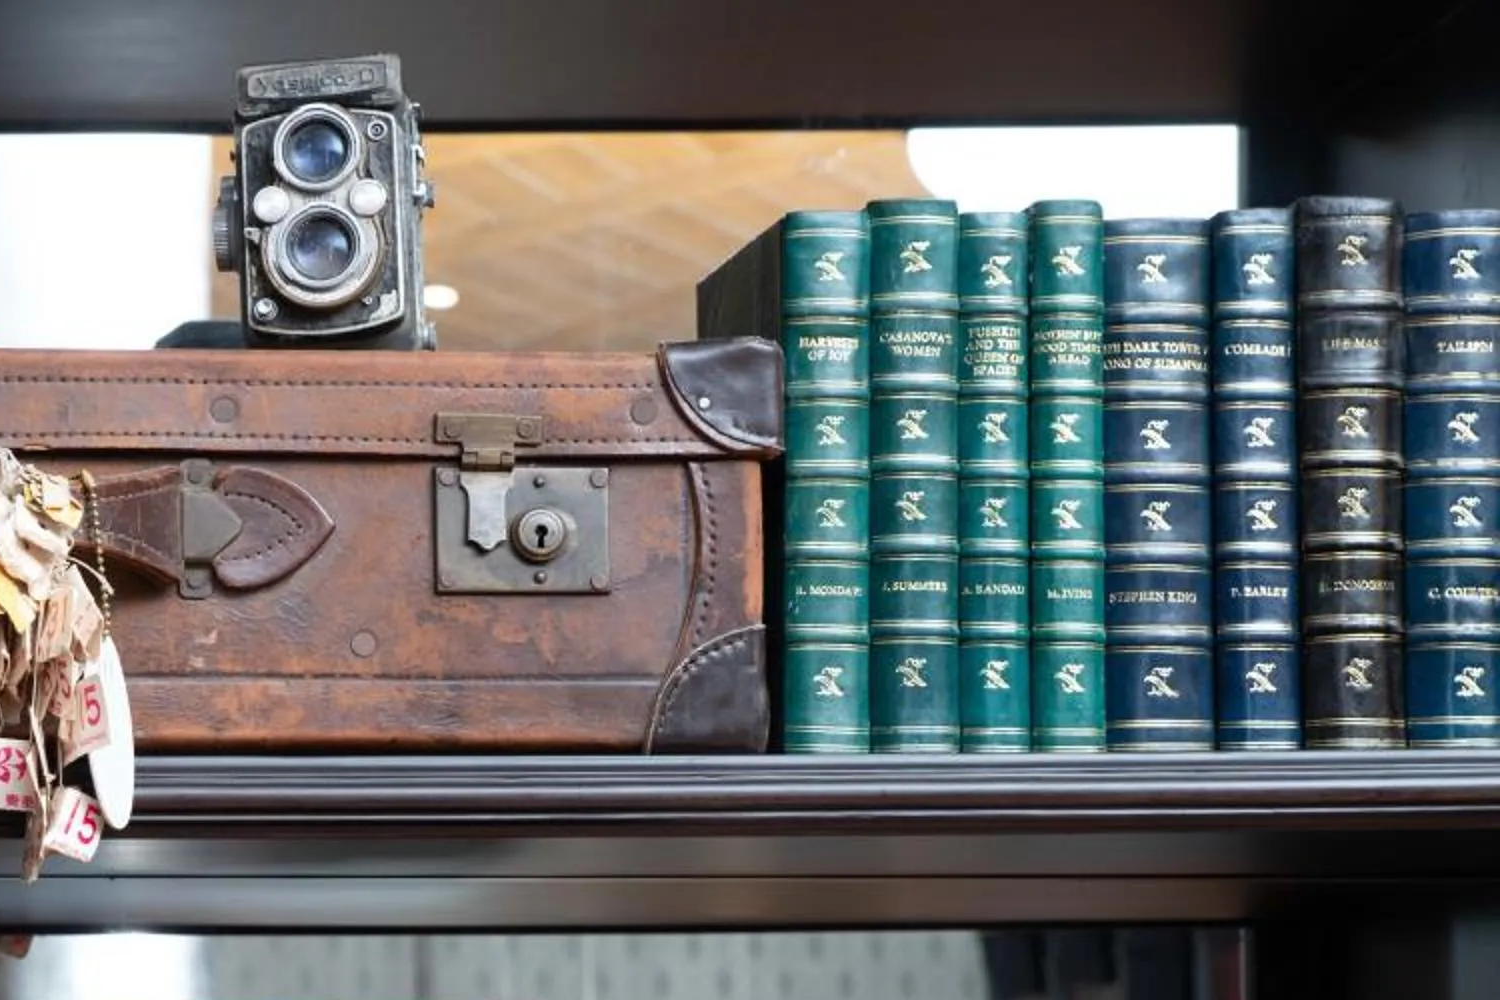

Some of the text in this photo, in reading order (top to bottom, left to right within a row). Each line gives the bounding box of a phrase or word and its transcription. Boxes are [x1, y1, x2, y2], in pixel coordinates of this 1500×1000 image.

[967, 340, 993, 351] AND
[1123, 342, 1160, 354] DARK
[808, 350, 825, 361] OF
[892, 346, 940, 357] WOMEN
[1134, 357, 1151, 368] OF
[892, 581, 948, 592] SUMMERS
[1167, 591, 1197, 604] KING
[1428, 586, 1440, 600] C.
[84, 685, 100, 726] 5
[77, 803, 101, 845] 5
